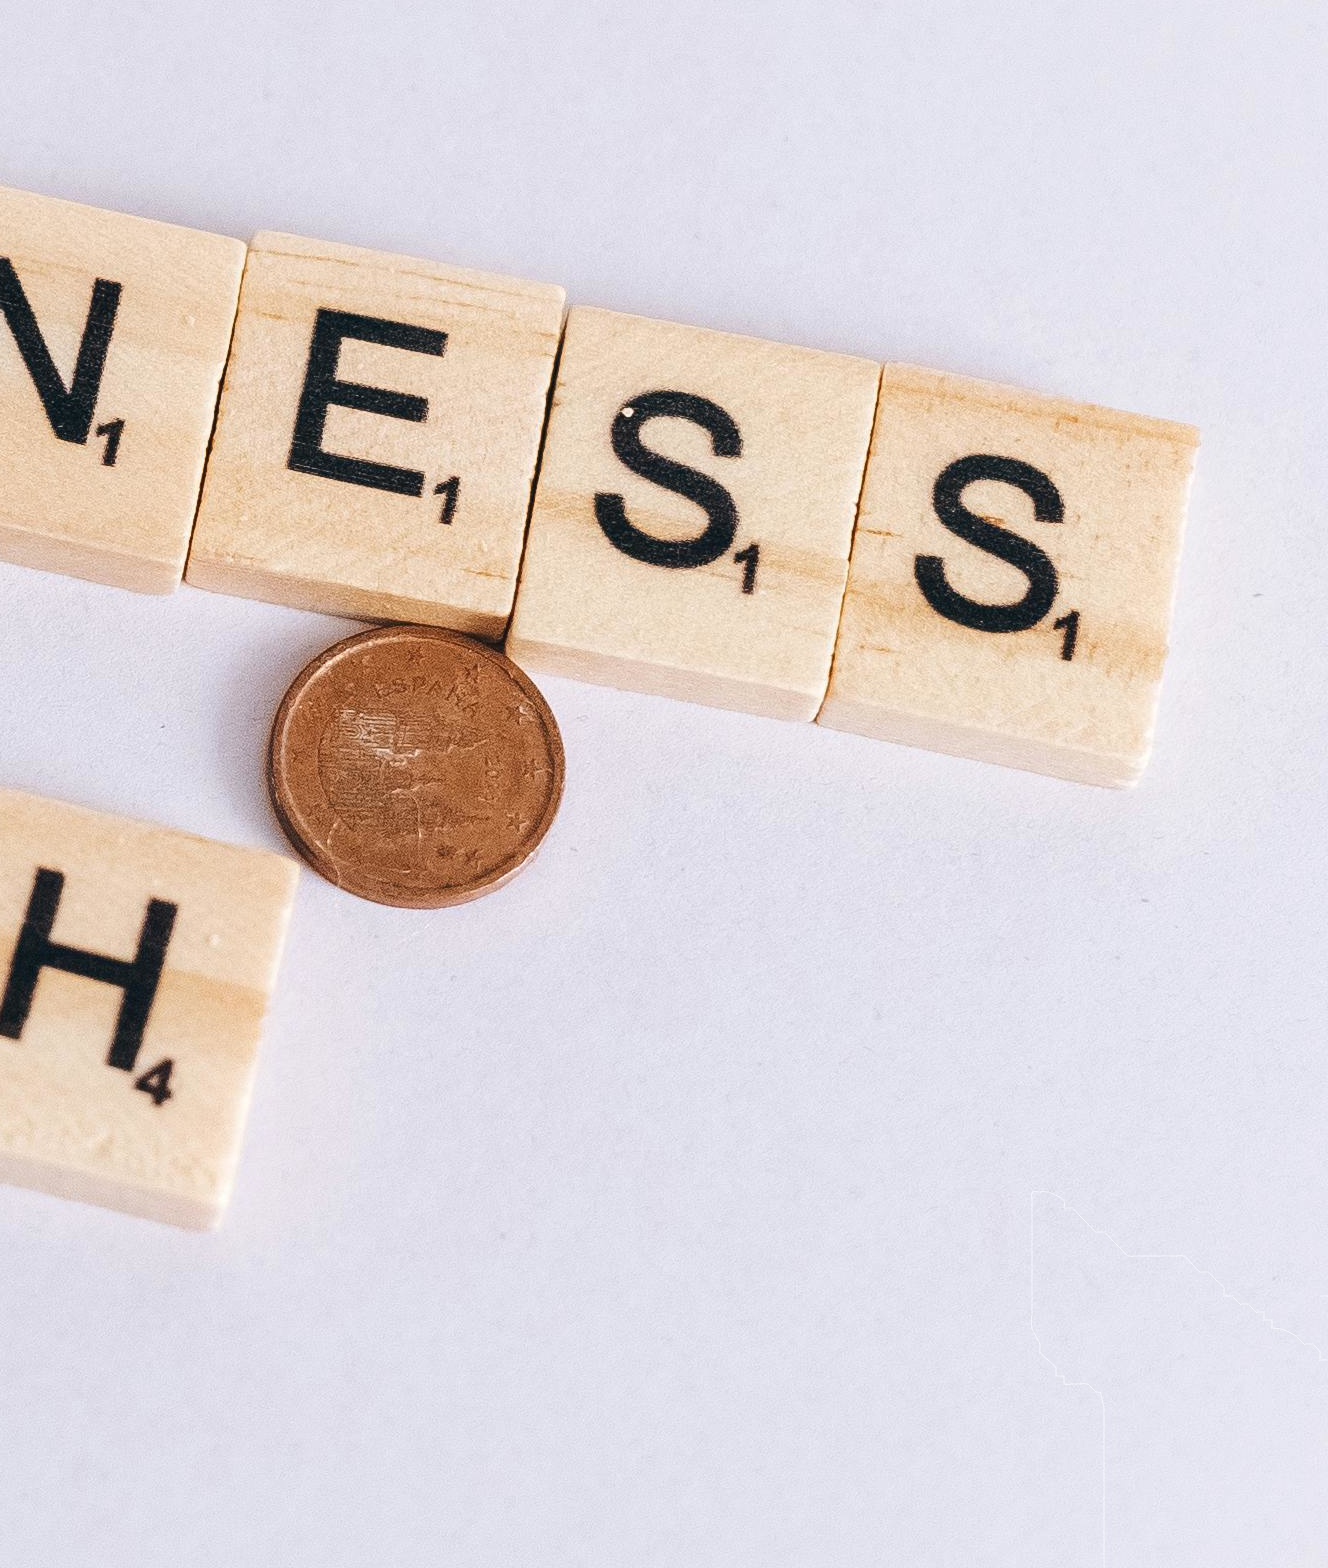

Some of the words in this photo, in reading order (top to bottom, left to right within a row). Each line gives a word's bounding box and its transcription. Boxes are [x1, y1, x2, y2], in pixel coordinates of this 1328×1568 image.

[95, 419, 125, 467] 1
[434, 476, 460, 525] 1
[733, 543, 760, 594] 1
[1053, 610, 1080, 661] 1
[135, 1059, 174, 1106] 4
